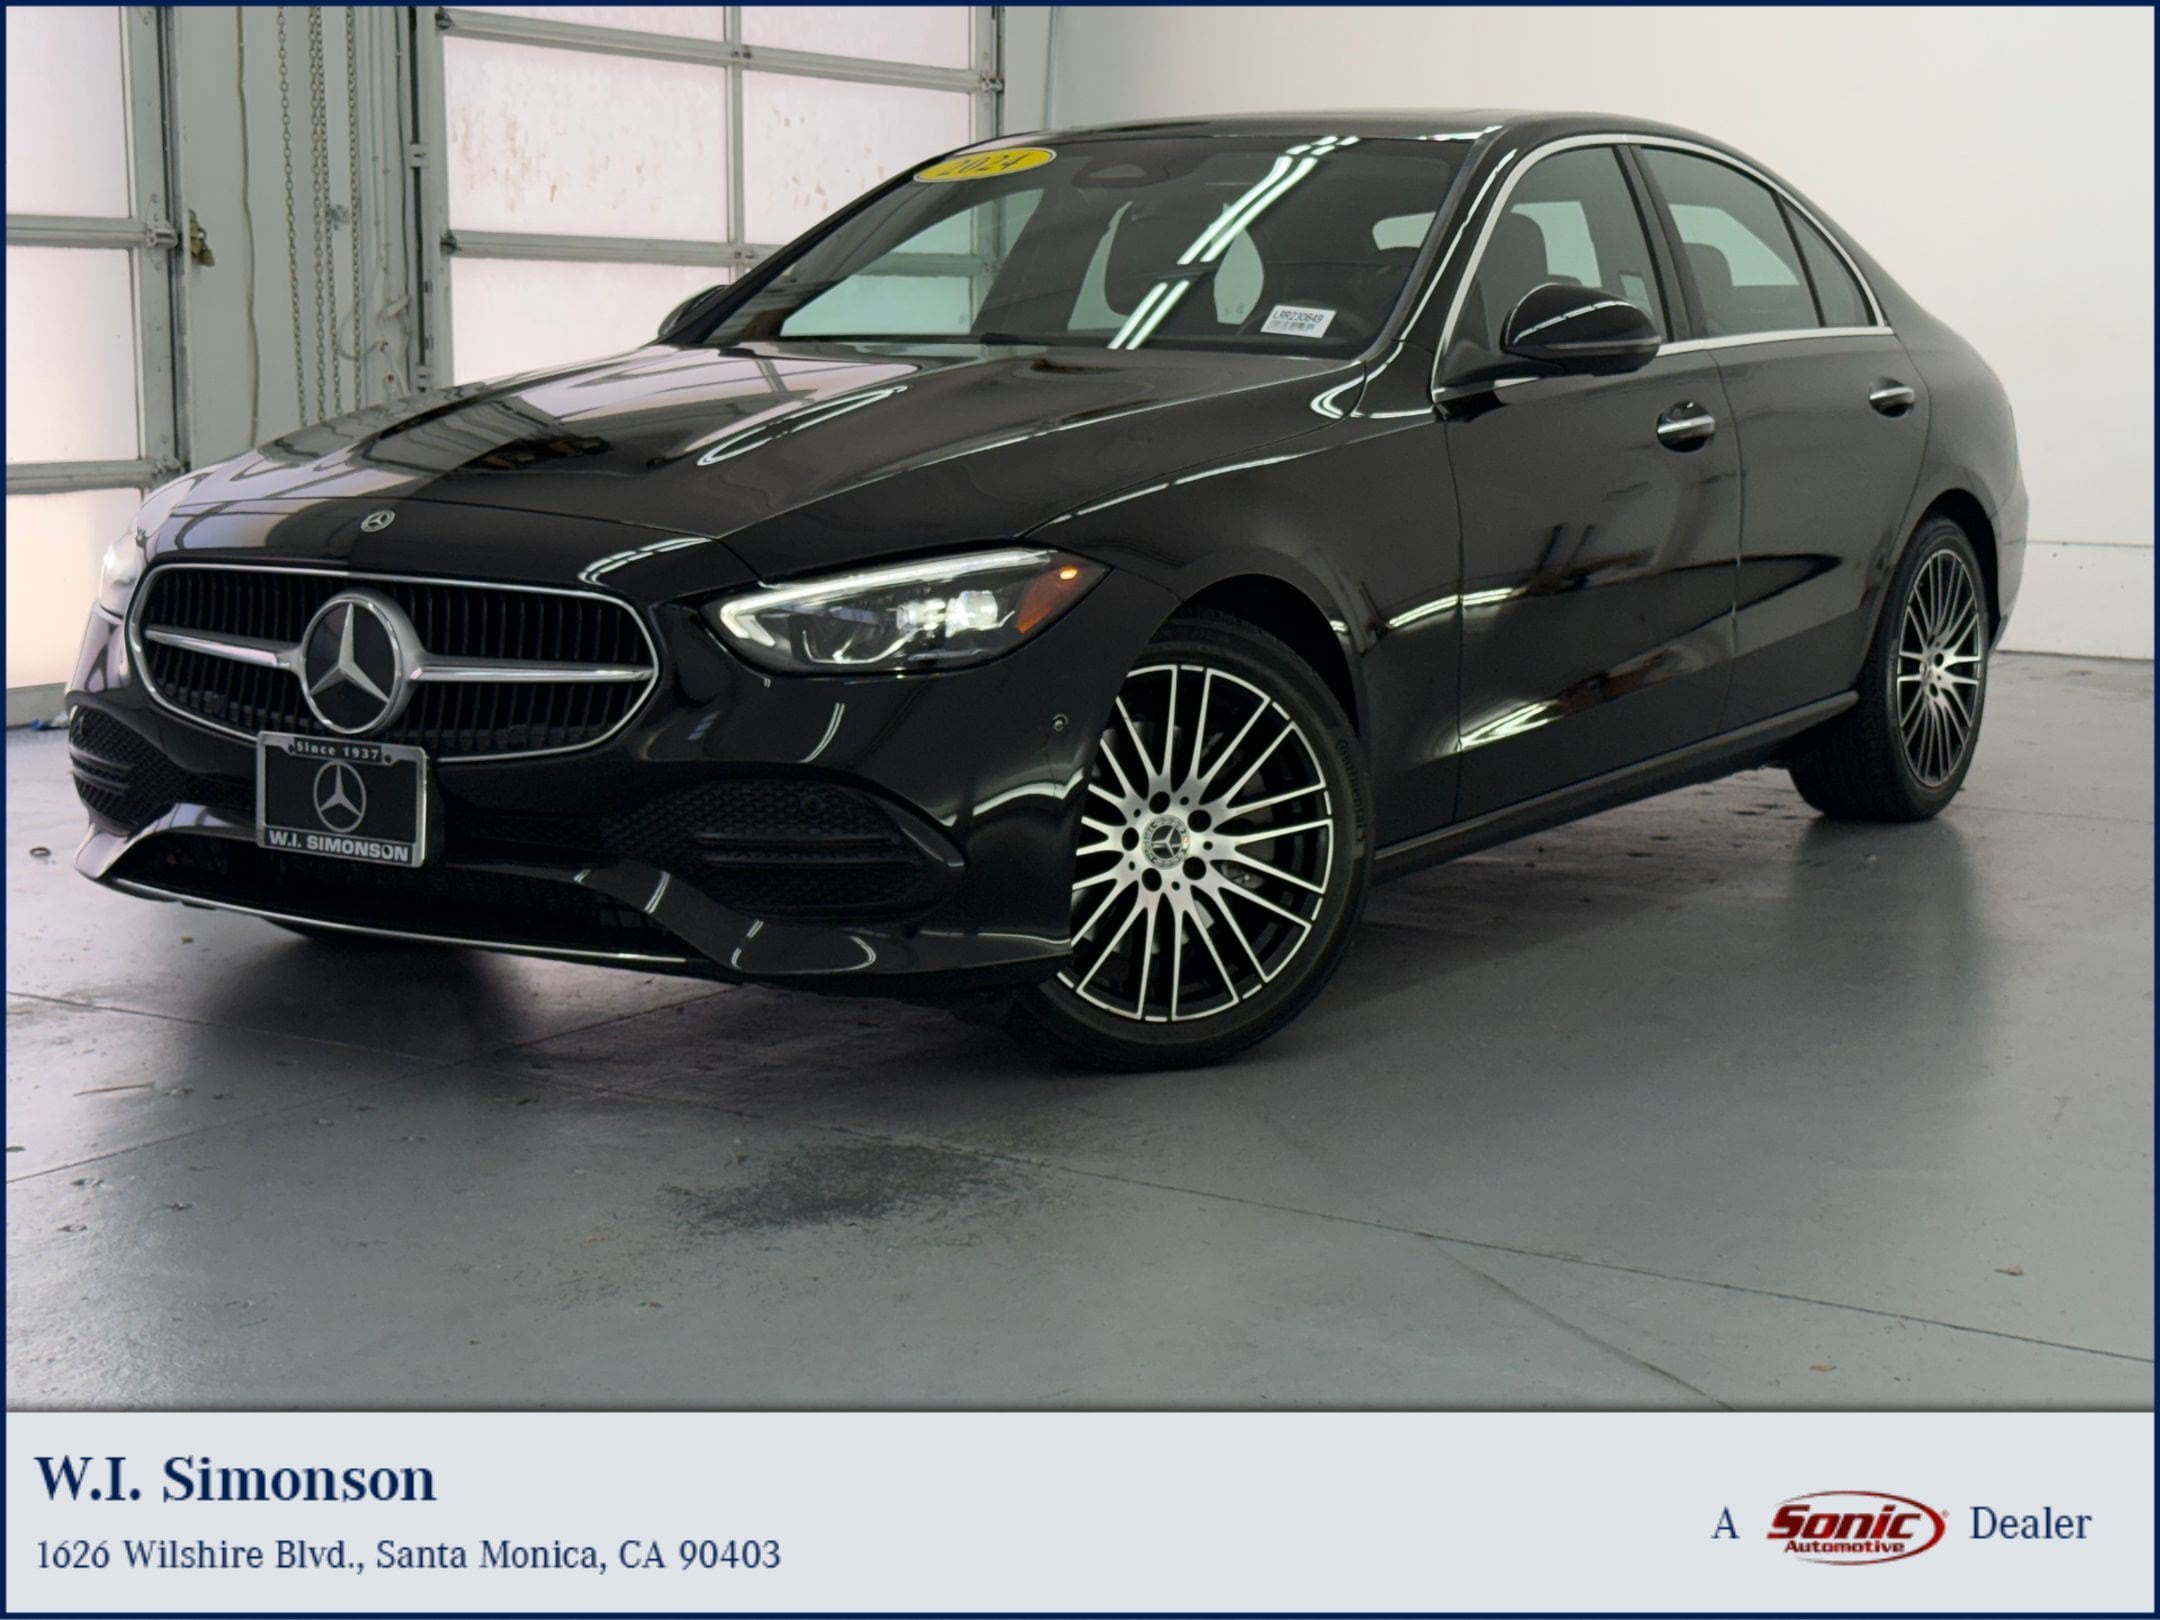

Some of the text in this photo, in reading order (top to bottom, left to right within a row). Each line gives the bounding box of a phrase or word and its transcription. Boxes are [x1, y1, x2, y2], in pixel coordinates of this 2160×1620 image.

[937, 151, 1031, 176] 2024
[295, 741, 380, 760] Since 1937
[268, 829, 409, 862] W.I. SIMONSON
